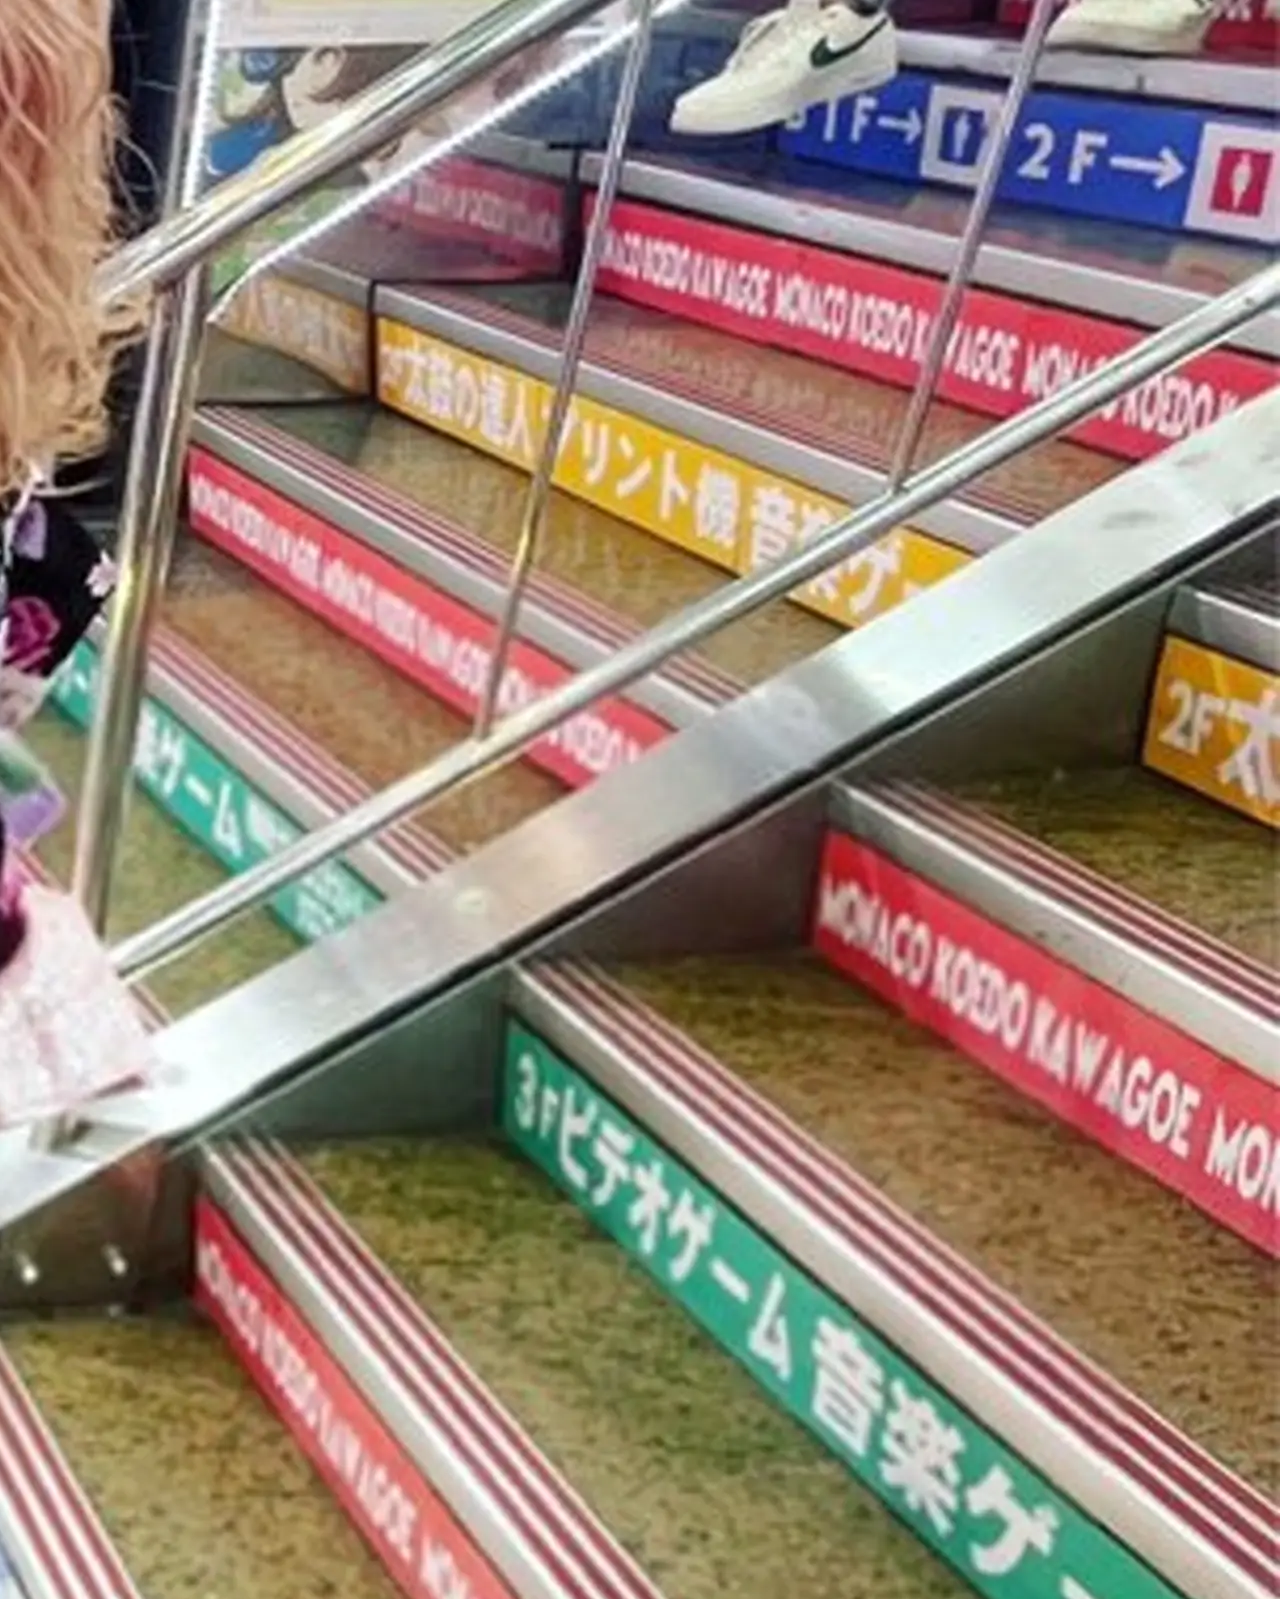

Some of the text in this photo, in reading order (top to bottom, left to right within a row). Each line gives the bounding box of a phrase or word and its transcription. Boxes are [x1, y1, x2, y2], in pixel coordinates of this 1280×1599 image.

[1017, 123, 1108, 184] 2F
[816, 874, 930, 988] MONACO
[937, 933, 1030, 1045] KOEDO
[1028, 991, 1201, 1160] KAWAGOE
